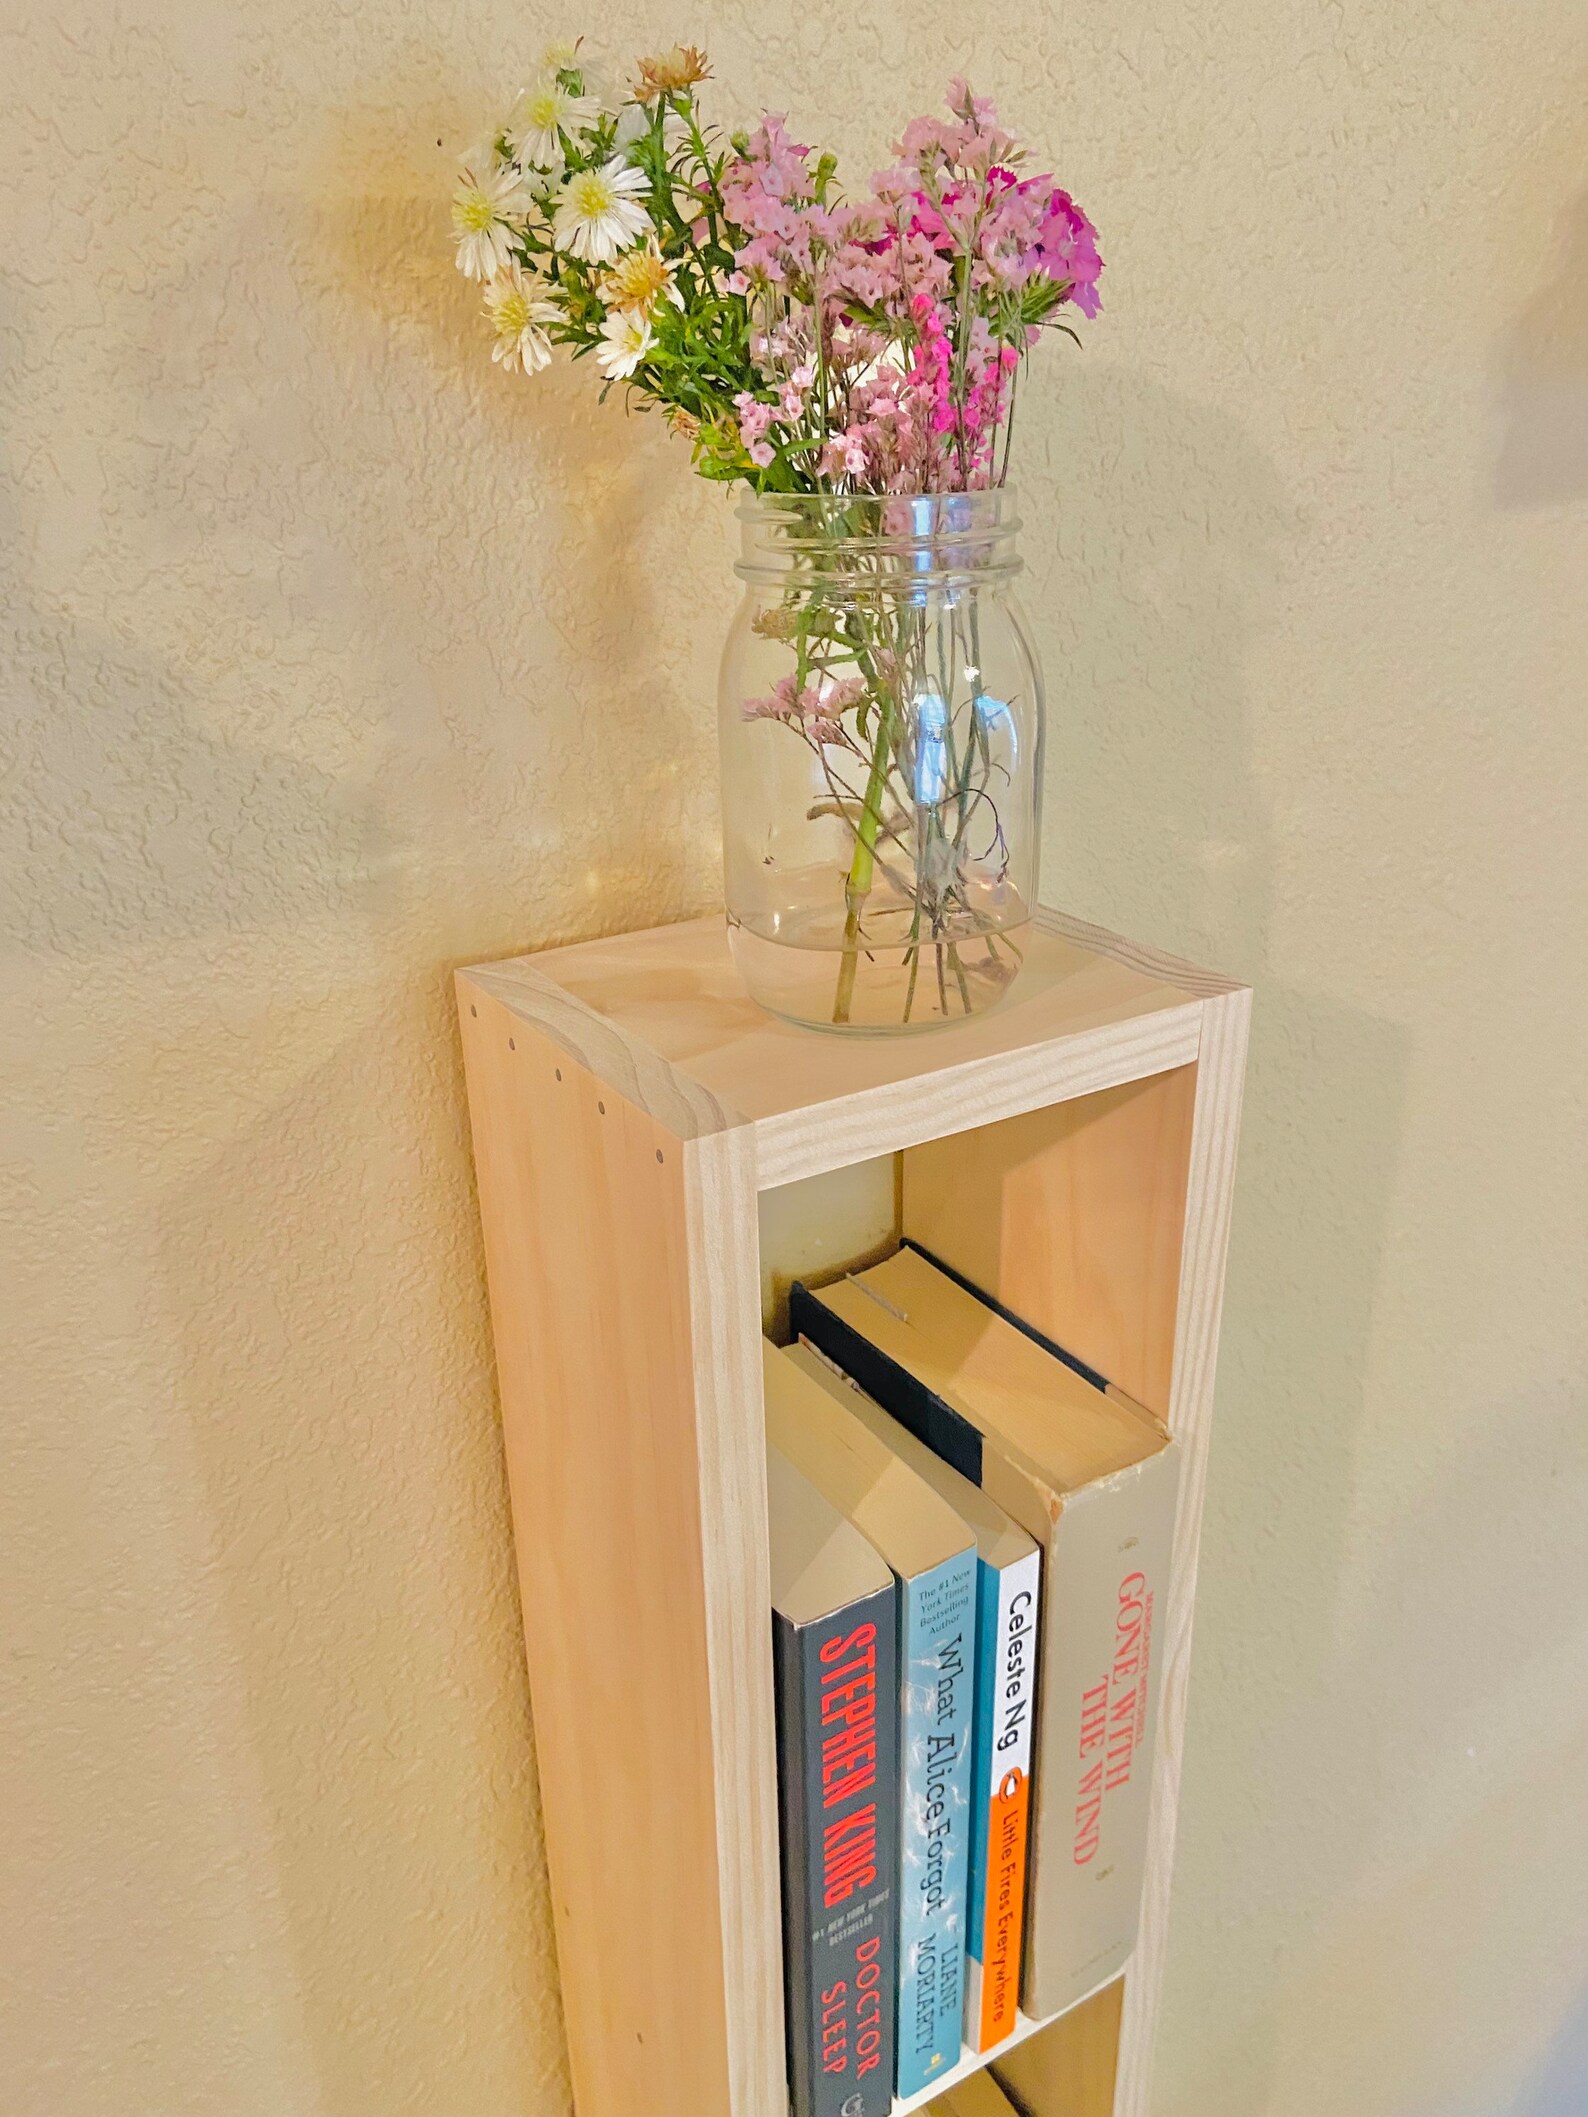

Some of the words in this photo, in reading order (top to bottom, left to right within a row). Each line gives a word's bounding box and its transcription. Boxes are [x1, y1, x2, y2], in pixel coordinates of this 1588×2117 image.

[920, 1589, 936, 1600] The
[939, 1579, 949, 1591] #1
[952, 1570, 970, 1584] New
[920, 1596, 969, 1627] Bestselling
[921, 1597, 941, 1613] York
[945, 1584, 969, 1600] Times
[929, 1614, 960, 1636] Author
[1112, 1572, 1145, 1685] GONE
[936, 1632, 964, 1725] What
[1005, 1591, 1033, 1699] Celeste
[820, 1622, 877, 1808] STEPHEN
[997, 1699, 1027, 1751] Ng
[1079, 1674, 1109, 1759] THE
[1105, 1688, 1137, 1791] WITH
[926, 1734, 956, 1820] Alice
[1073, 1760, 1103, 1866] WIND
[823, 1803, 878, 1909] KING
[920, 1822, 951, 1917] Forgot
[1000, 1809, 1019, 1860] Little
[998, 1862, 1017, 1911] Fires
[856, 1936, 881, 2080] DOCTOR
[915, 1932, 937, 2054] MORIARTY
[939, 1943, 958, 2017] LIANE
[991, 1912, 1014, 2022] Everywhere
[821, 1980, 848, 2074] SLEEP
